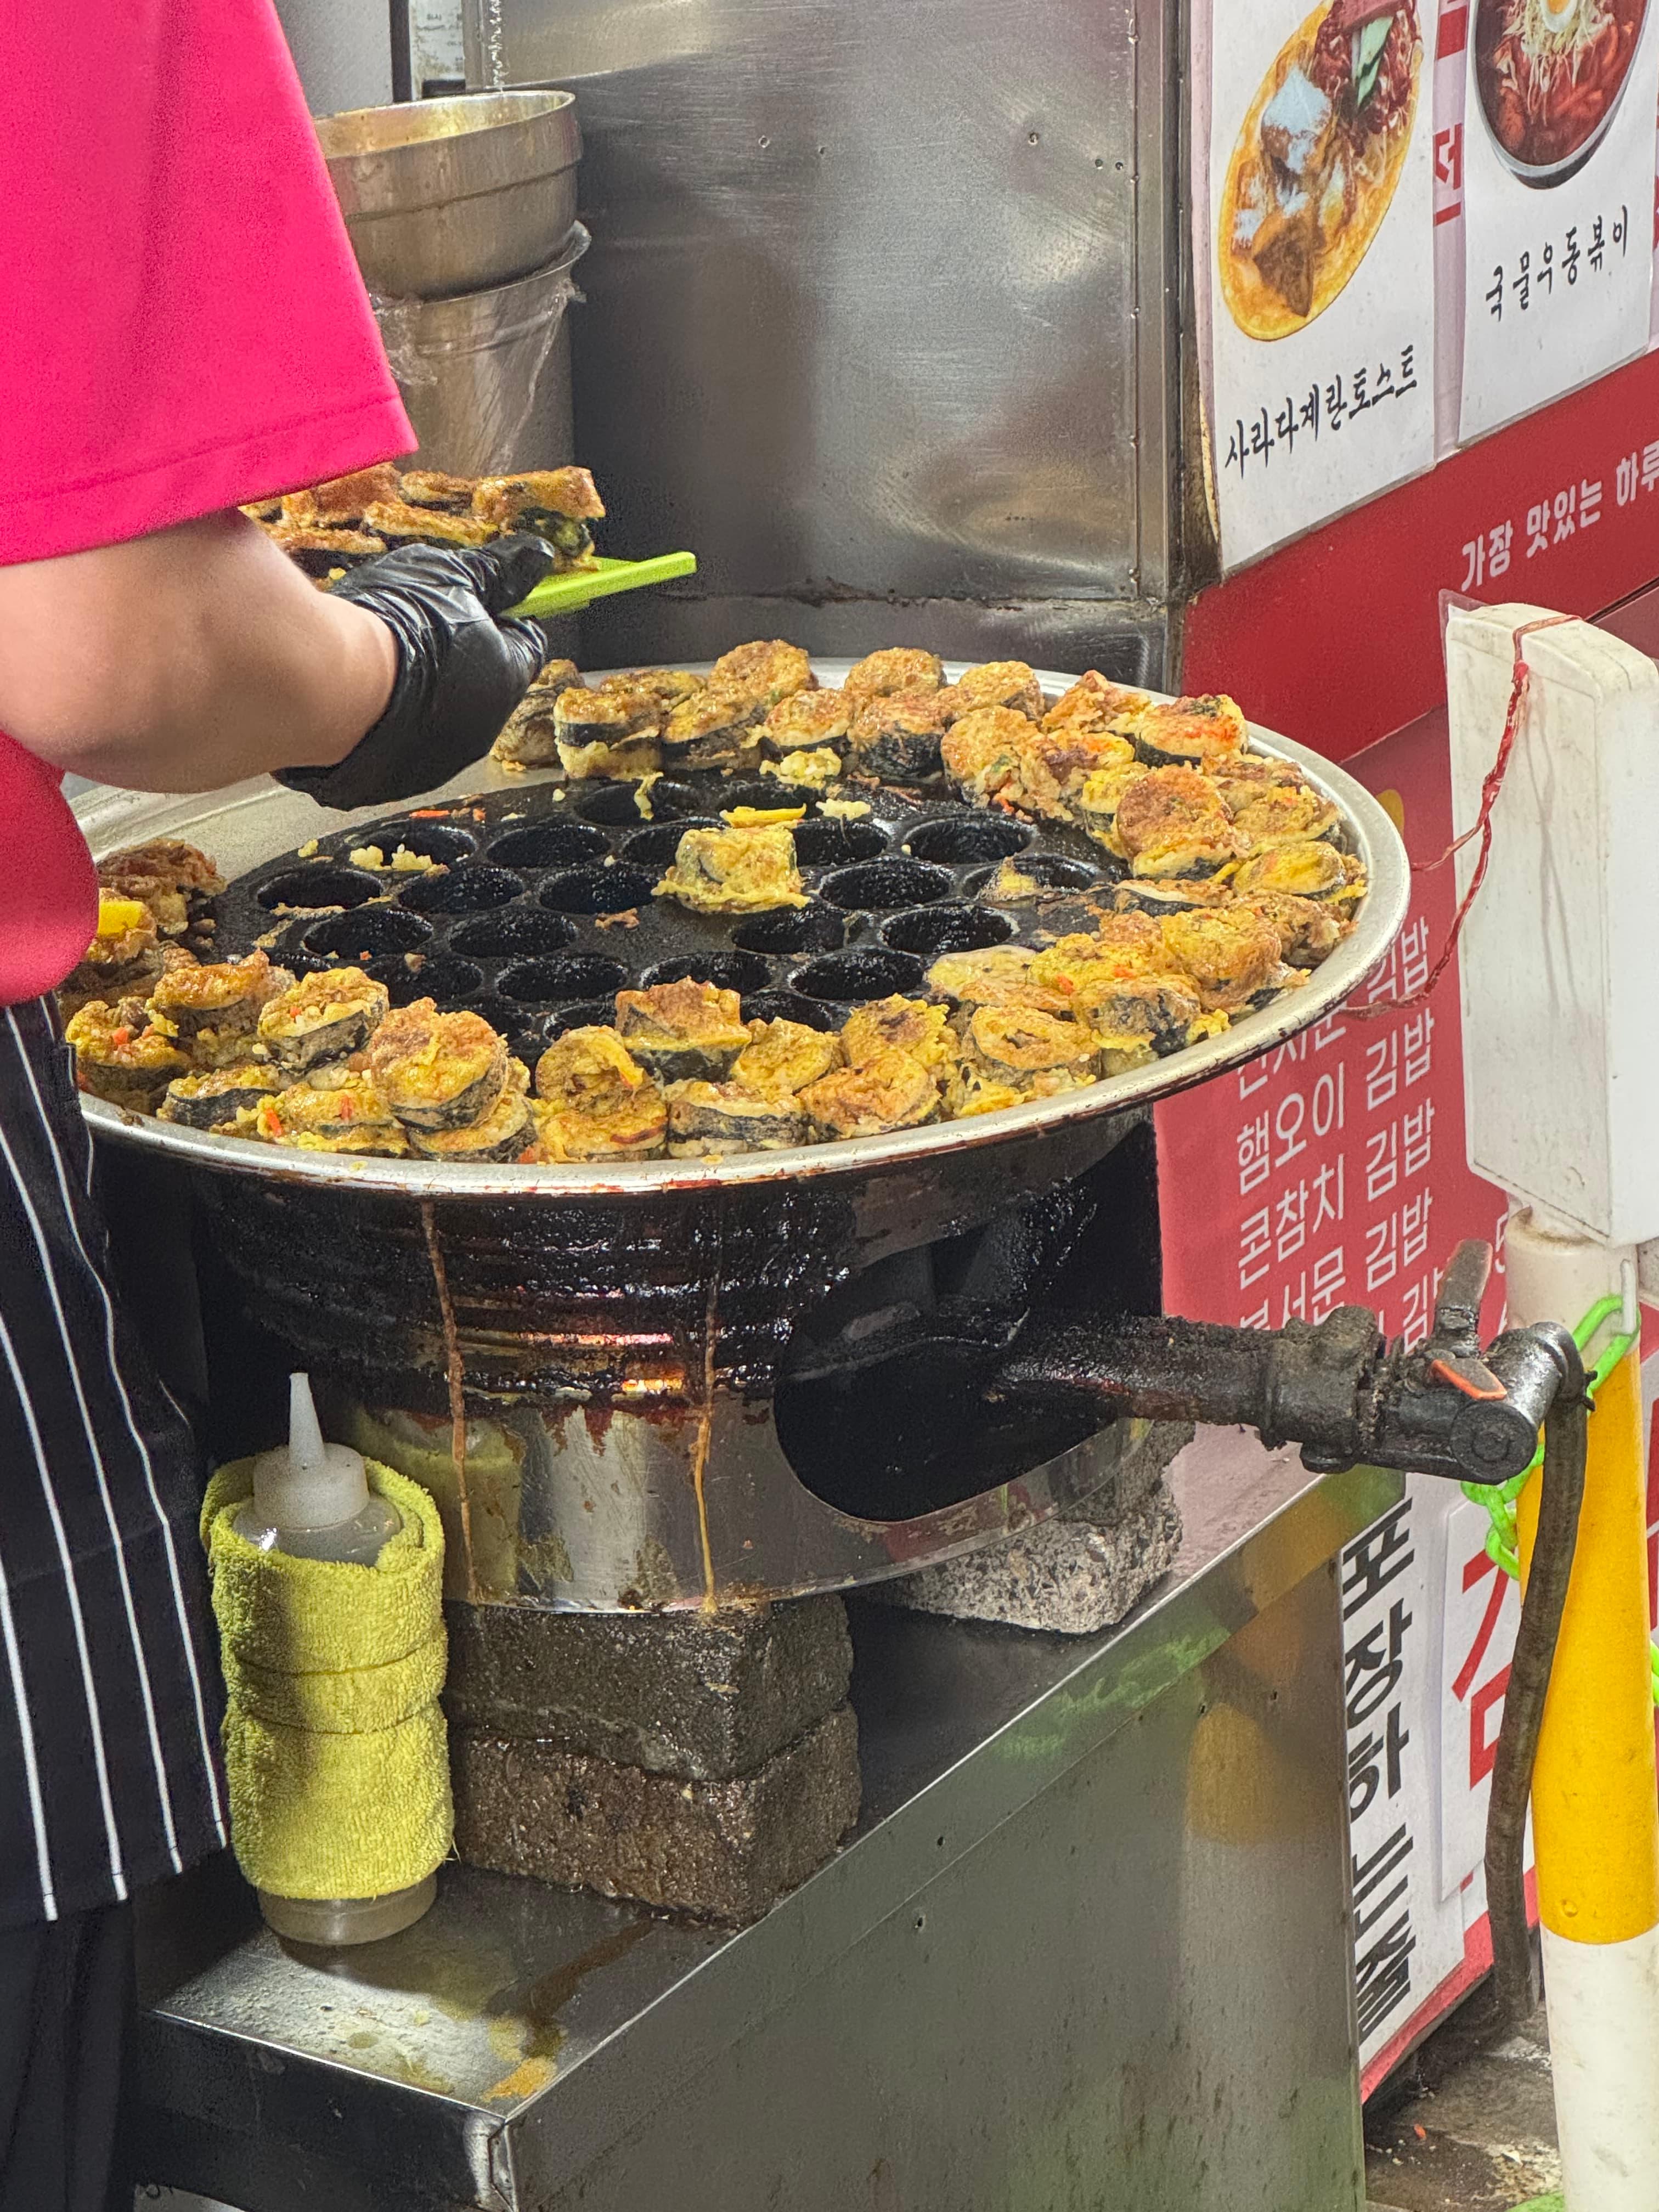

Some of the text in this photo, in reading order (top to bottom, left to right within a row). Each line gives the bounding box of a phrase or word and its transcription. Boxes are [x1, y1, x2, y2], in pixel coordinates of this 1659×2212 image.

[1486, 205, 1628, 322] 국물우동볶이
[1224, 345, 1417, 479] 사라다계란토스트
[1462, 520, 1513, 591] 가장
[1526, 479, 1602, 558] 맛있는
[1237, 1061, 1344, 1195] 햄오이
[1366, 1007, 1435, 1111] 김밥
[1238, 1098, 1435, 1290] 콘참치 김밥
[1365, 1187, 1433, 1292] 김밥
